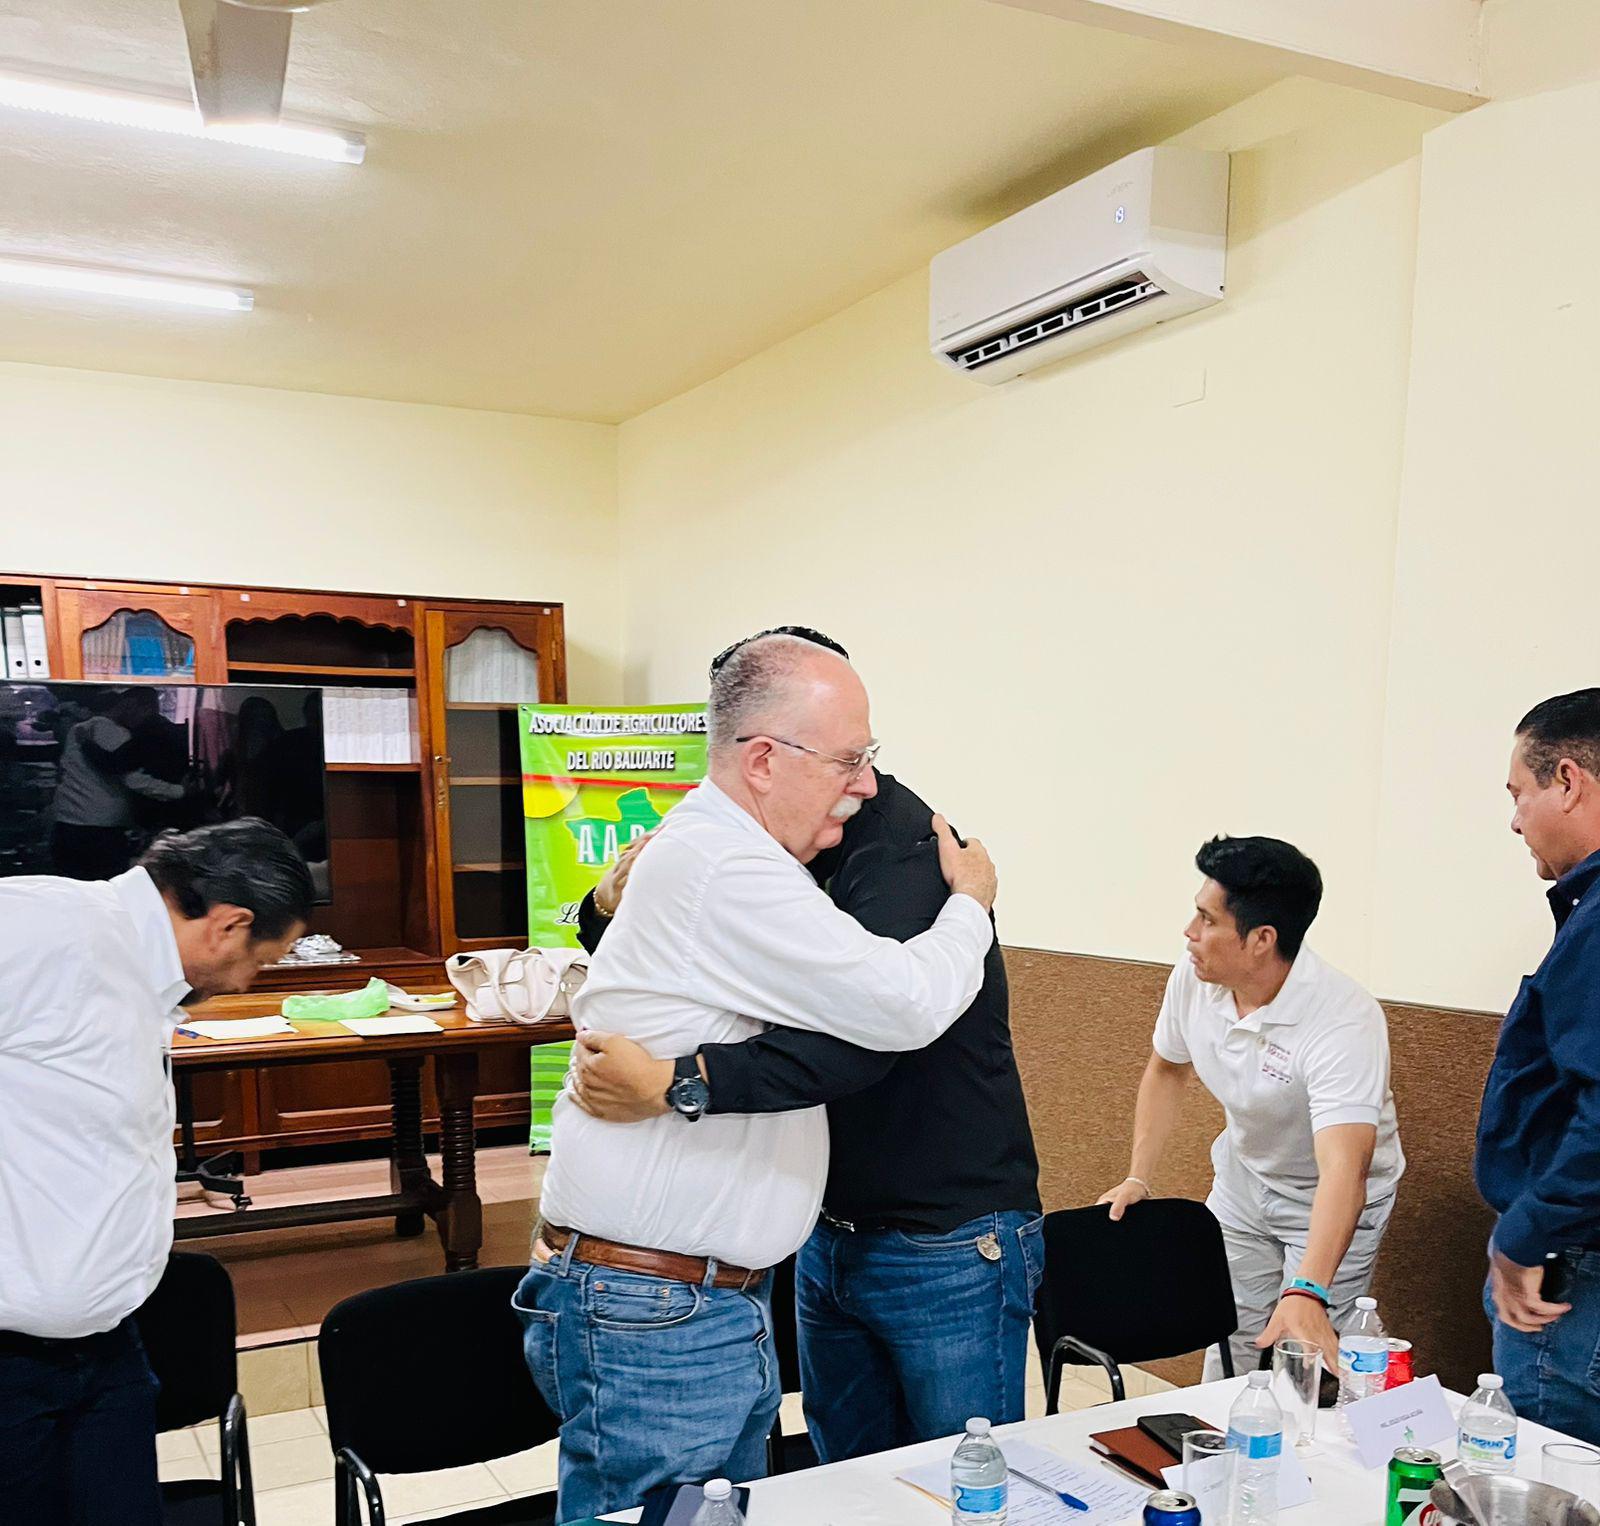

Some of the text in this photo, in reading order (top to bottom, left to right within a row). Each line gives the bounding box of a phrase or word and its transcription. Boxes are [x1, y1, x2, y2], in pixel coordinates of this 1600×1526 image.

[567, 751, 675, 771] DEL RIO BALUARTE
